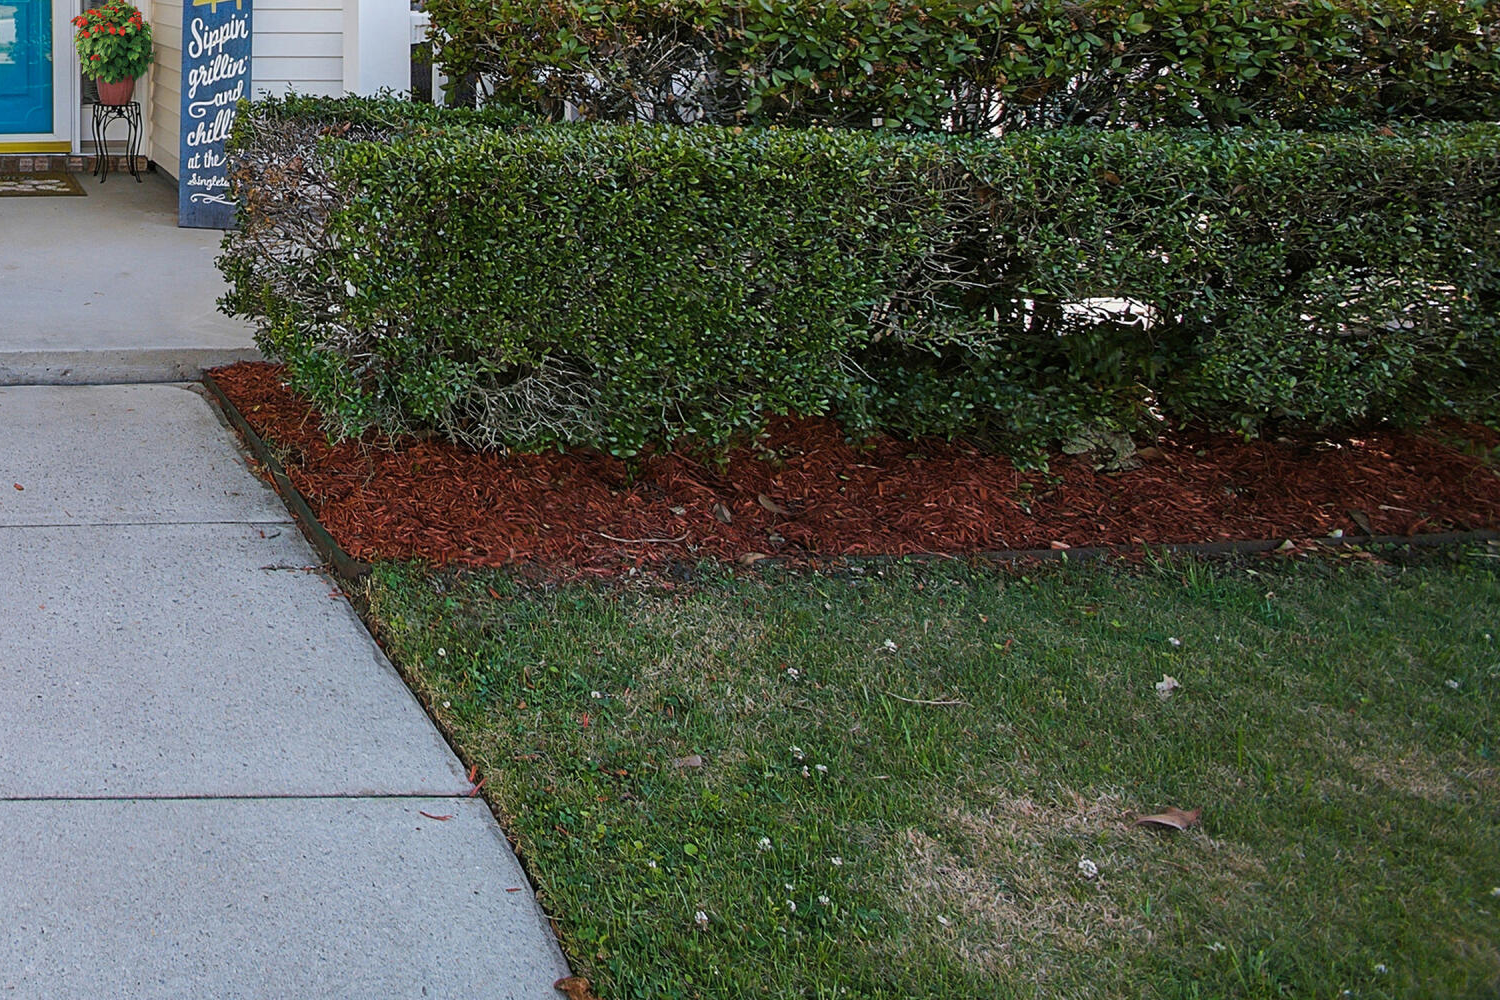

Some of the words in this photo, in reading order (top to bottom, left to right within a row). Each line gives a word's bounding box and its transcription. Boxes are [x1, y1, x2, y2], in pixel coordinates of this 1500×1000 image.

[188, 13, 249, 58] Sippin'
[188, 53, 248, 99] grillin'
[214, 79, 244, 107] and
[187, 108, 236, 147] chilli
[187, 152, 201, 169] at
[203, 148, 229, 169] the
